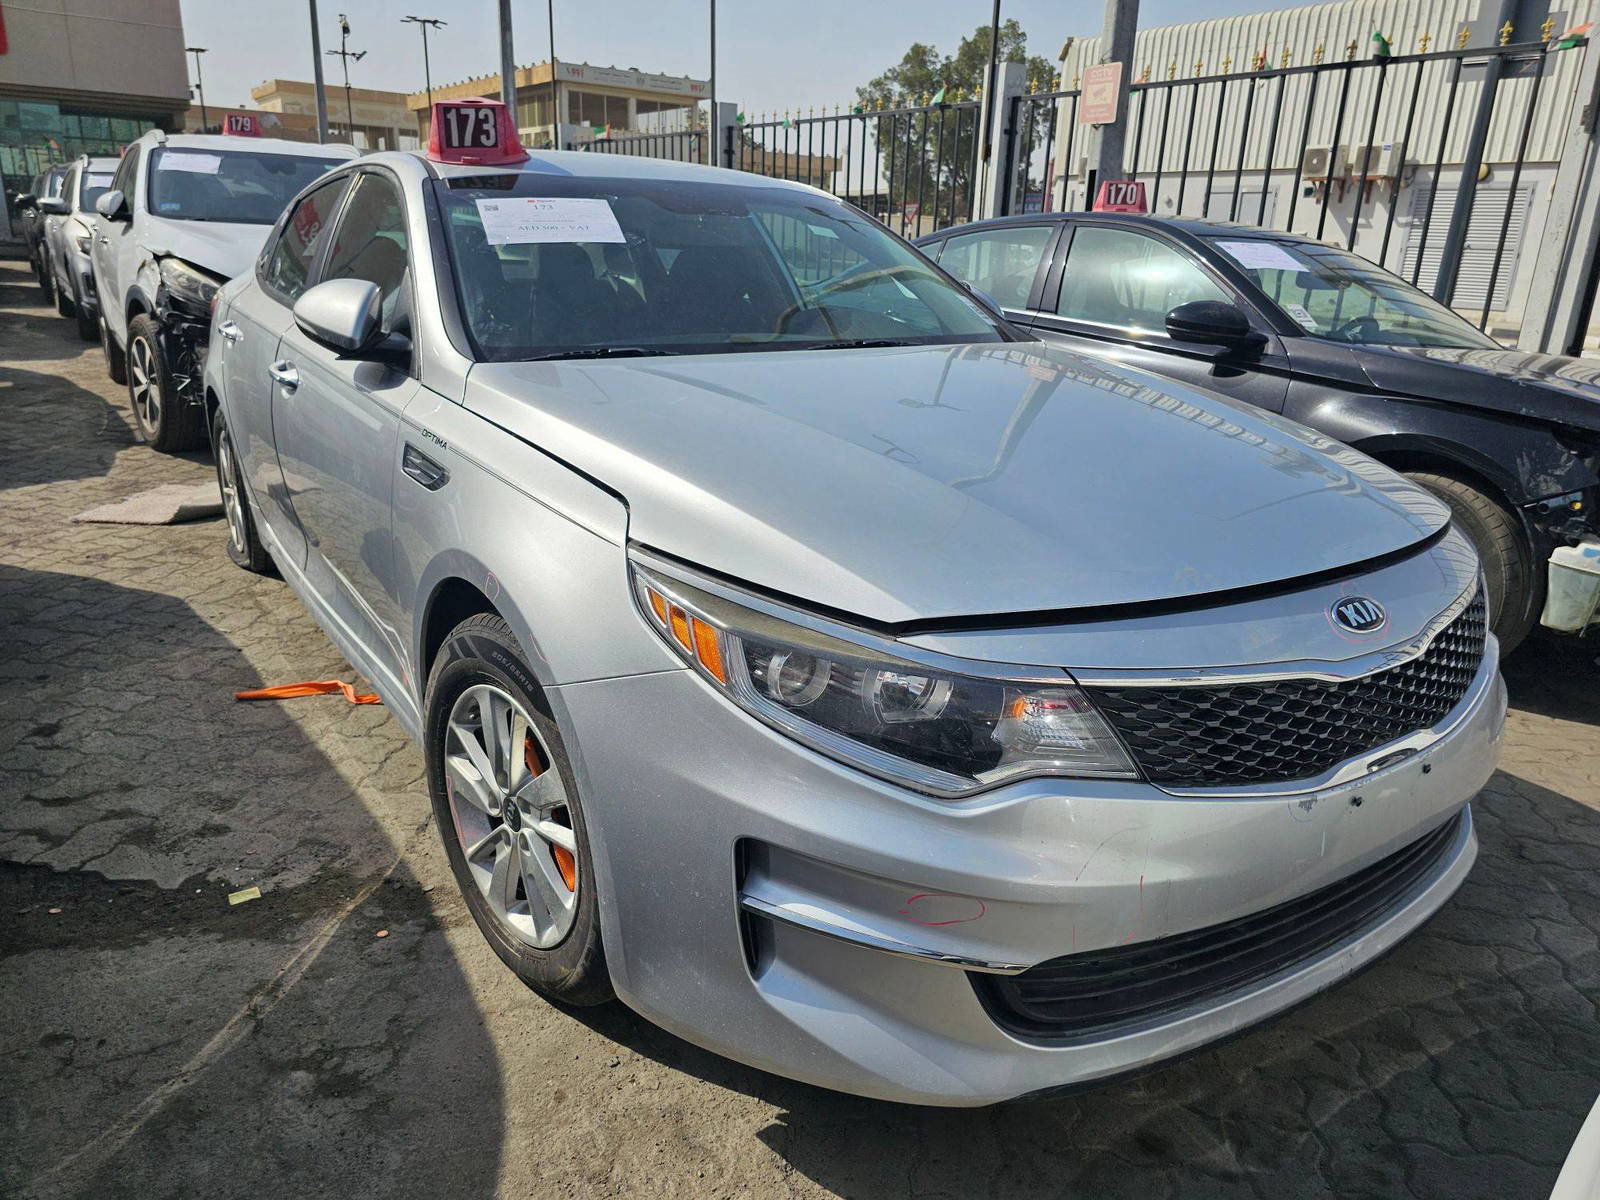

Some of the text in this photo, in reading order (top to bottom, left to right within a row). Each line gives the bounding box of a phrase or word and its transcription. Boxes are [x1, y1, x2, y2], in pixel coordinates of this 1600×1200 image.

[230, 116, 251, 131] 179
[446, 107, 496, 147] 173
[1109, 183, 1137, 205] 170
[421, 428, 448, 450] OPTIMA
[1338, 599, 1384, 627] KIA
